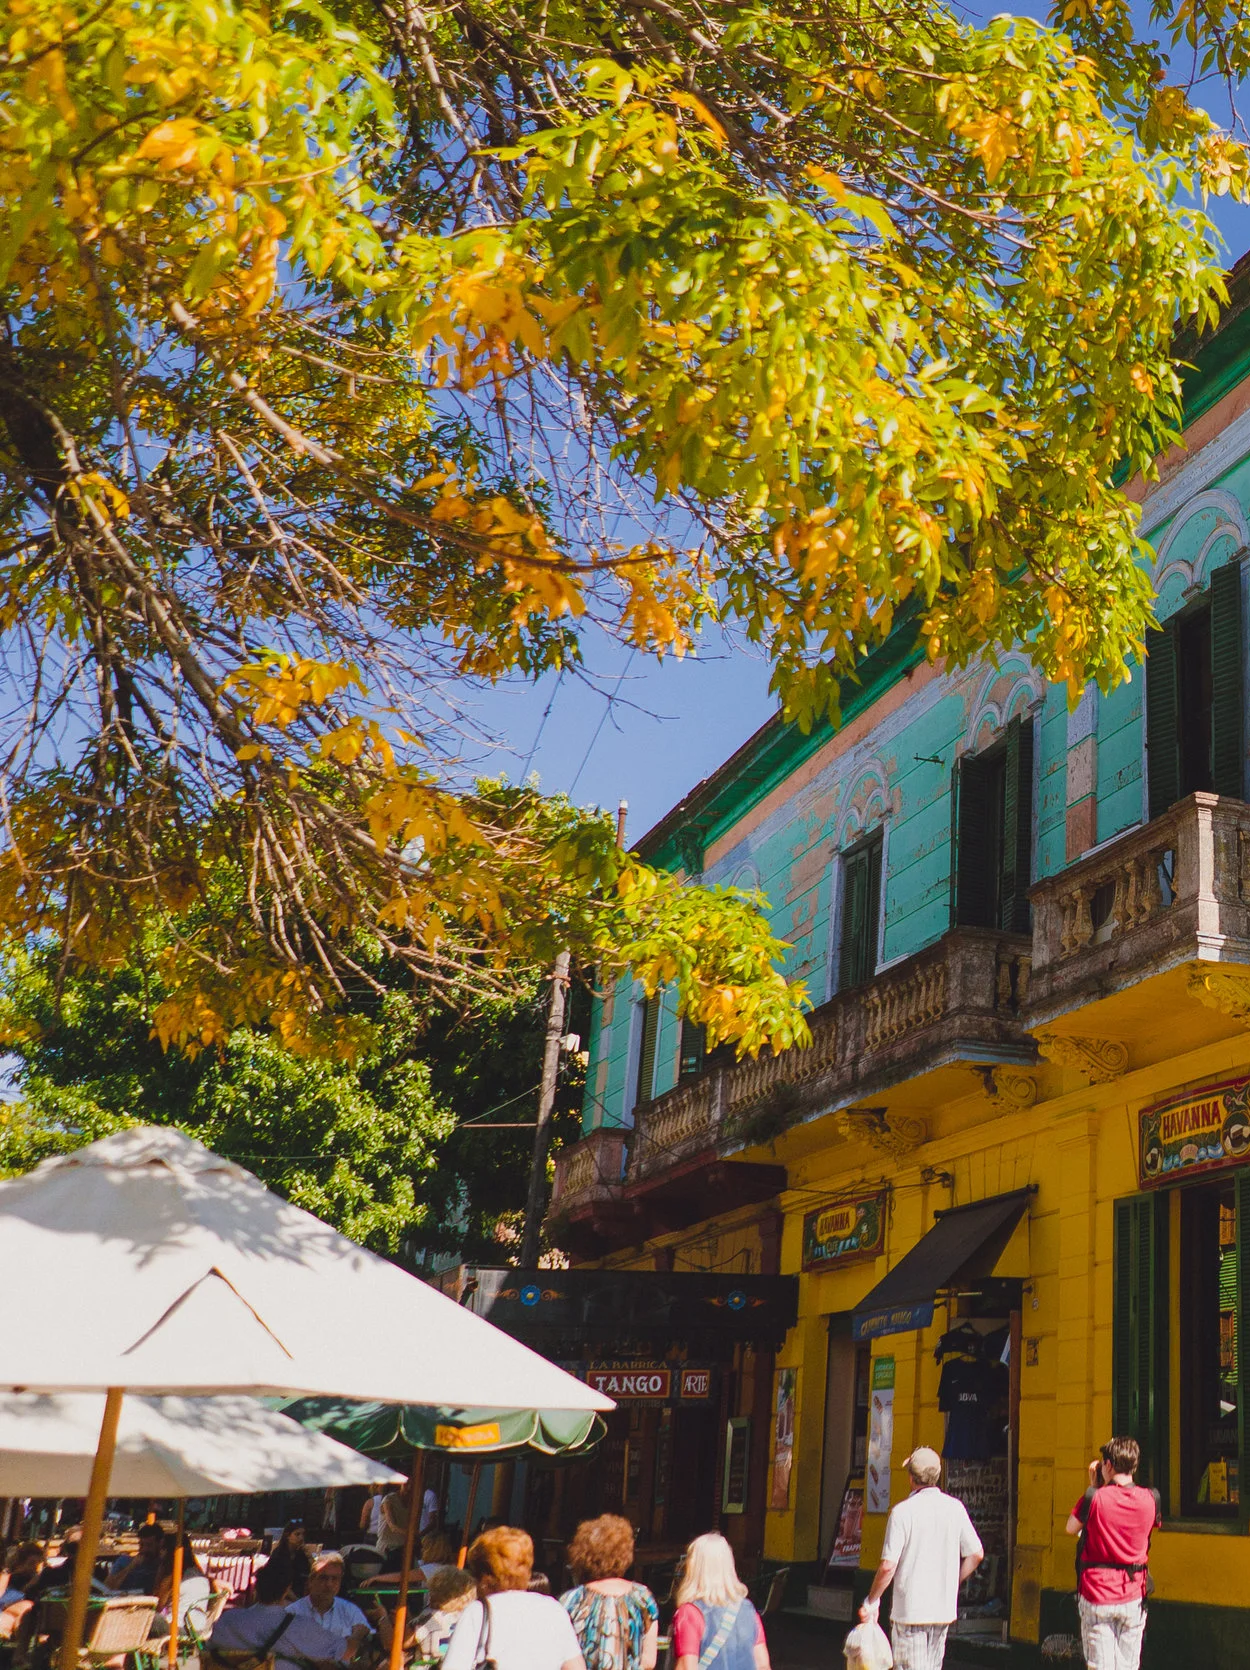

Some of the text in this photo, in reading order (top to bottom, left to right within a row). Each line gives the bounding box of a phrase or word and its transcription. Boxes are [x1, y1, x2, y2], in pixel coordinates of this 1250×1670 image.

[1163, 1100, 1222, 1140] HAVANNA
[590, 1360, 668, 1370] LA BARRICA
[595, 1375, 662, 1394] TANGO
[684, 1375, 709, 1394] ARTE
